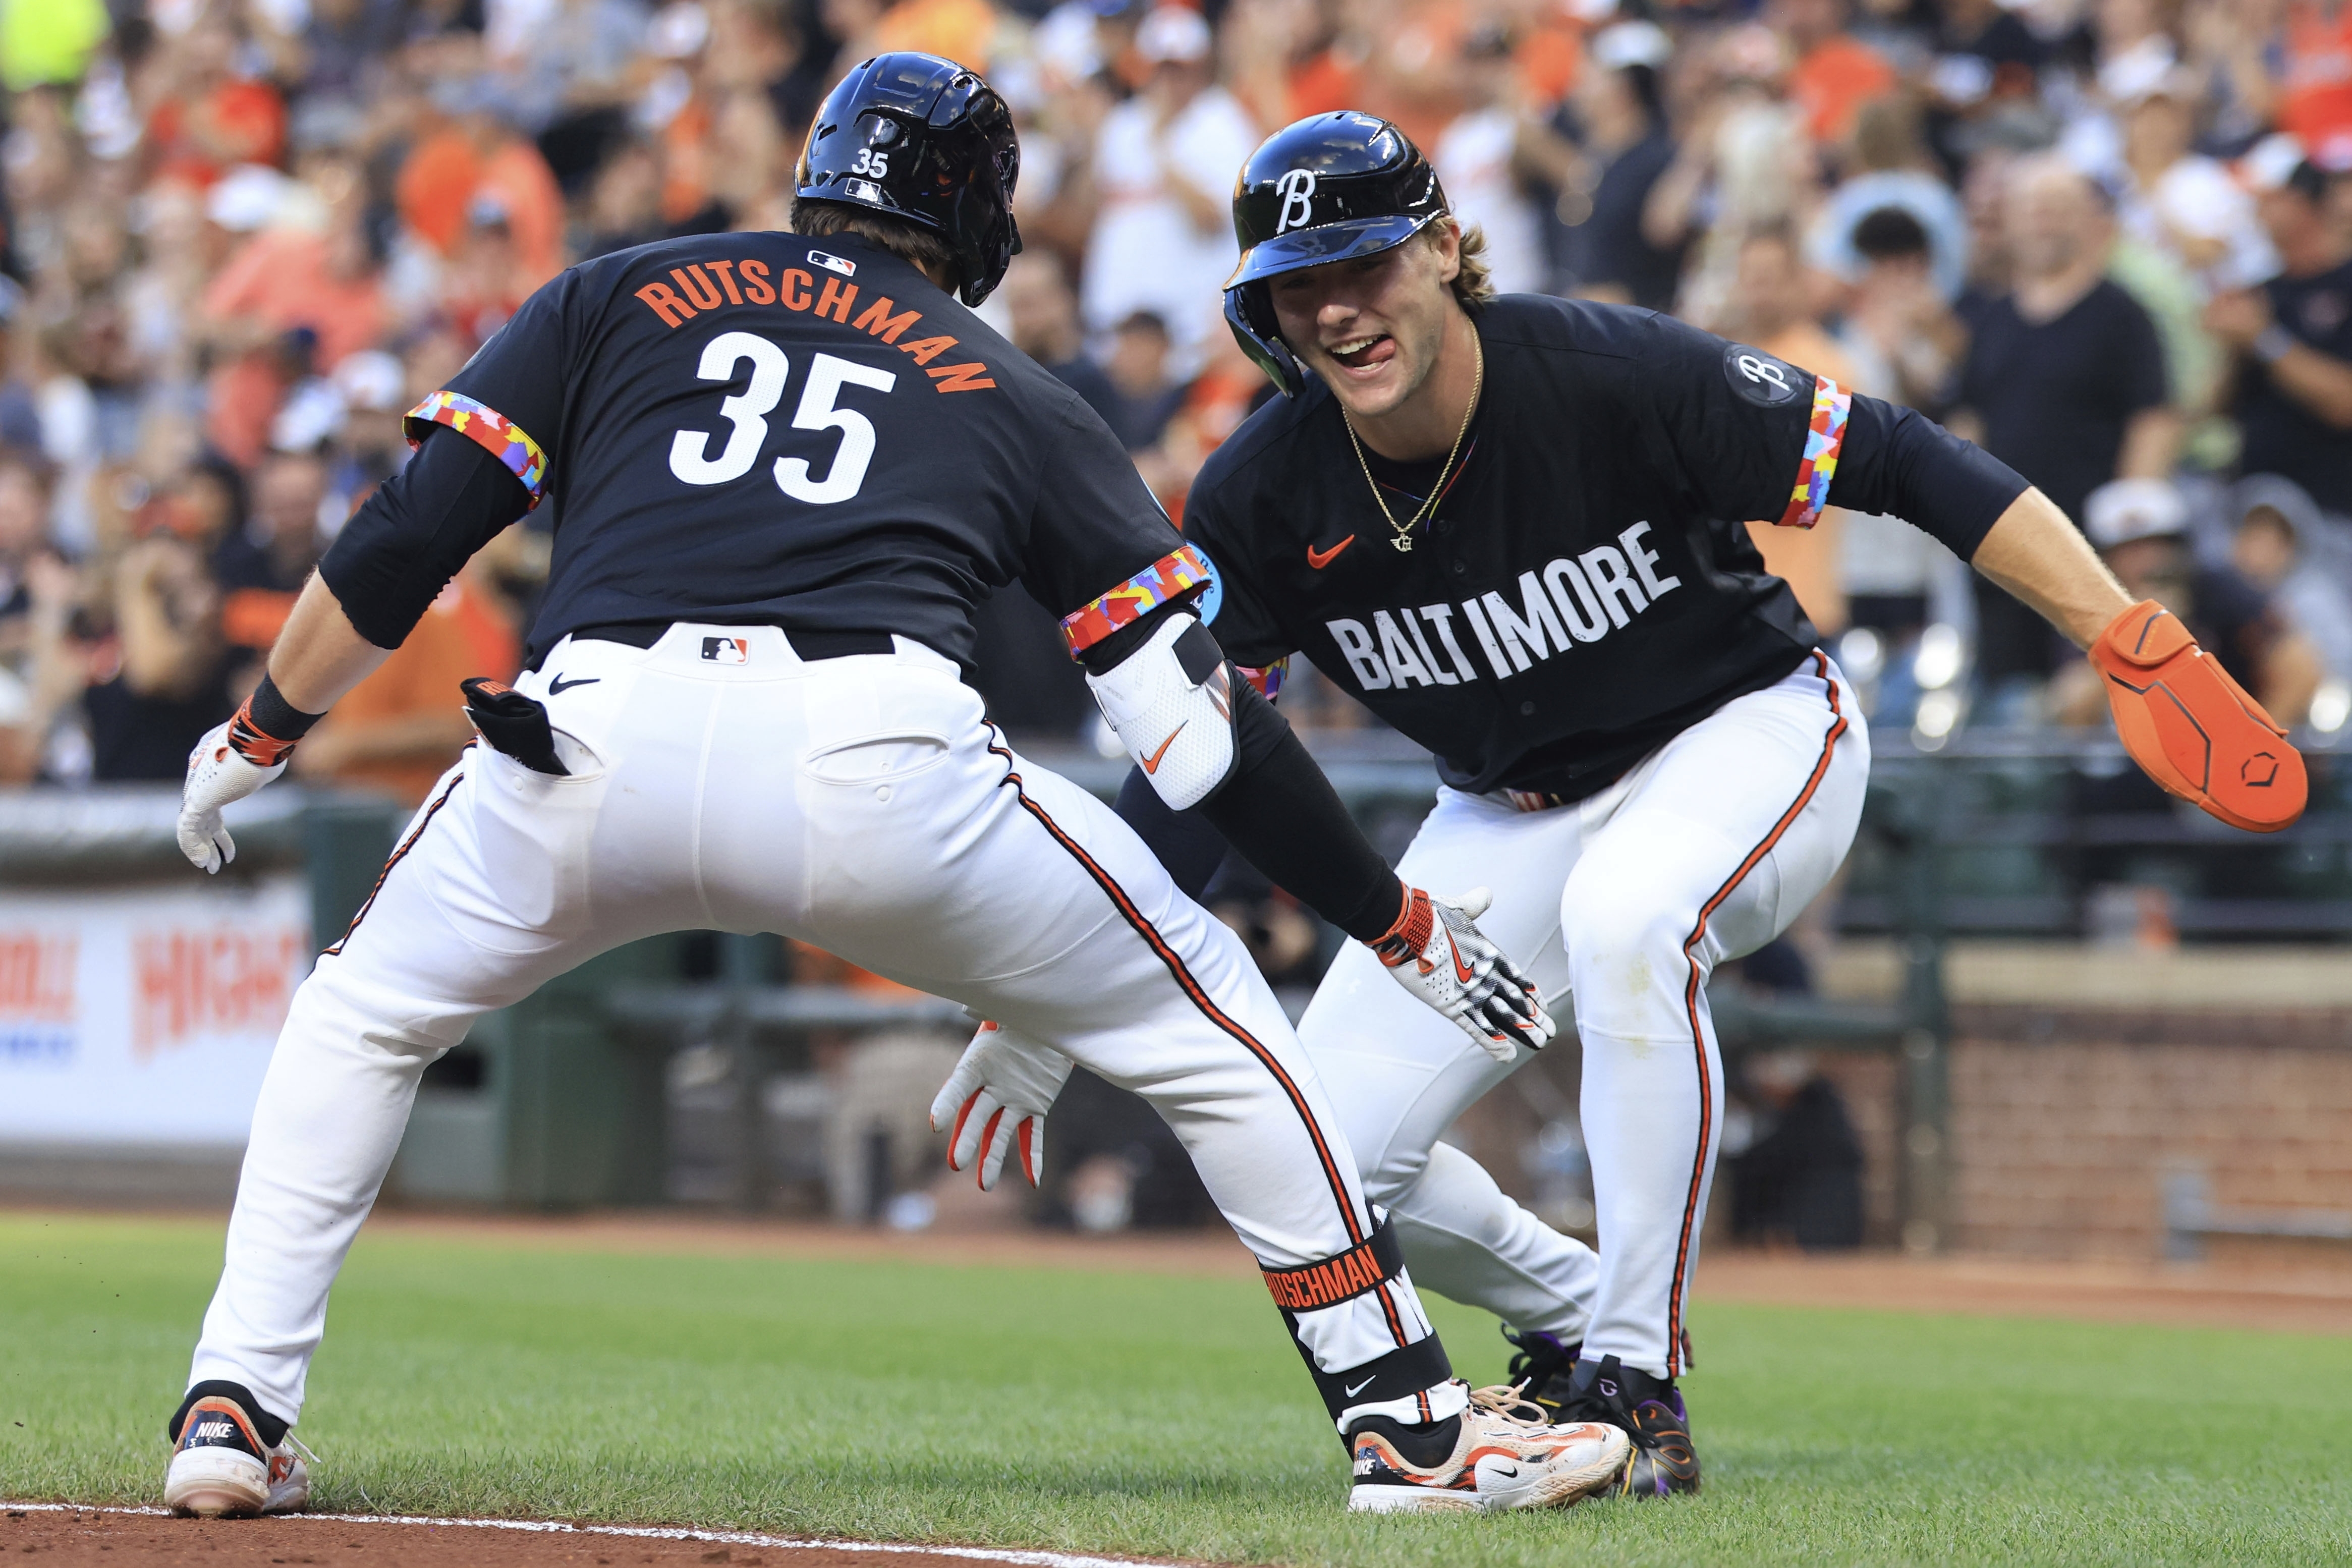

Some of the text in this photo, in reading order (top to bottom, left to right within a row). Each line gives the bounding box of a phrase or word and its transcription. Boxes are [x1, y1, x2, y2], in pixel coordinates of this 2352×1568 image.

[852, 148, 889, 179] 35
[1275, 169, 1316, 236] B
[634, 259, 997, 394] RUTSCHMAN
[668, 331, 898, 505] 35
[1325, 520, 1682, 691] BALTIMORE
[195, 1422, 234, 1438] NIKE
